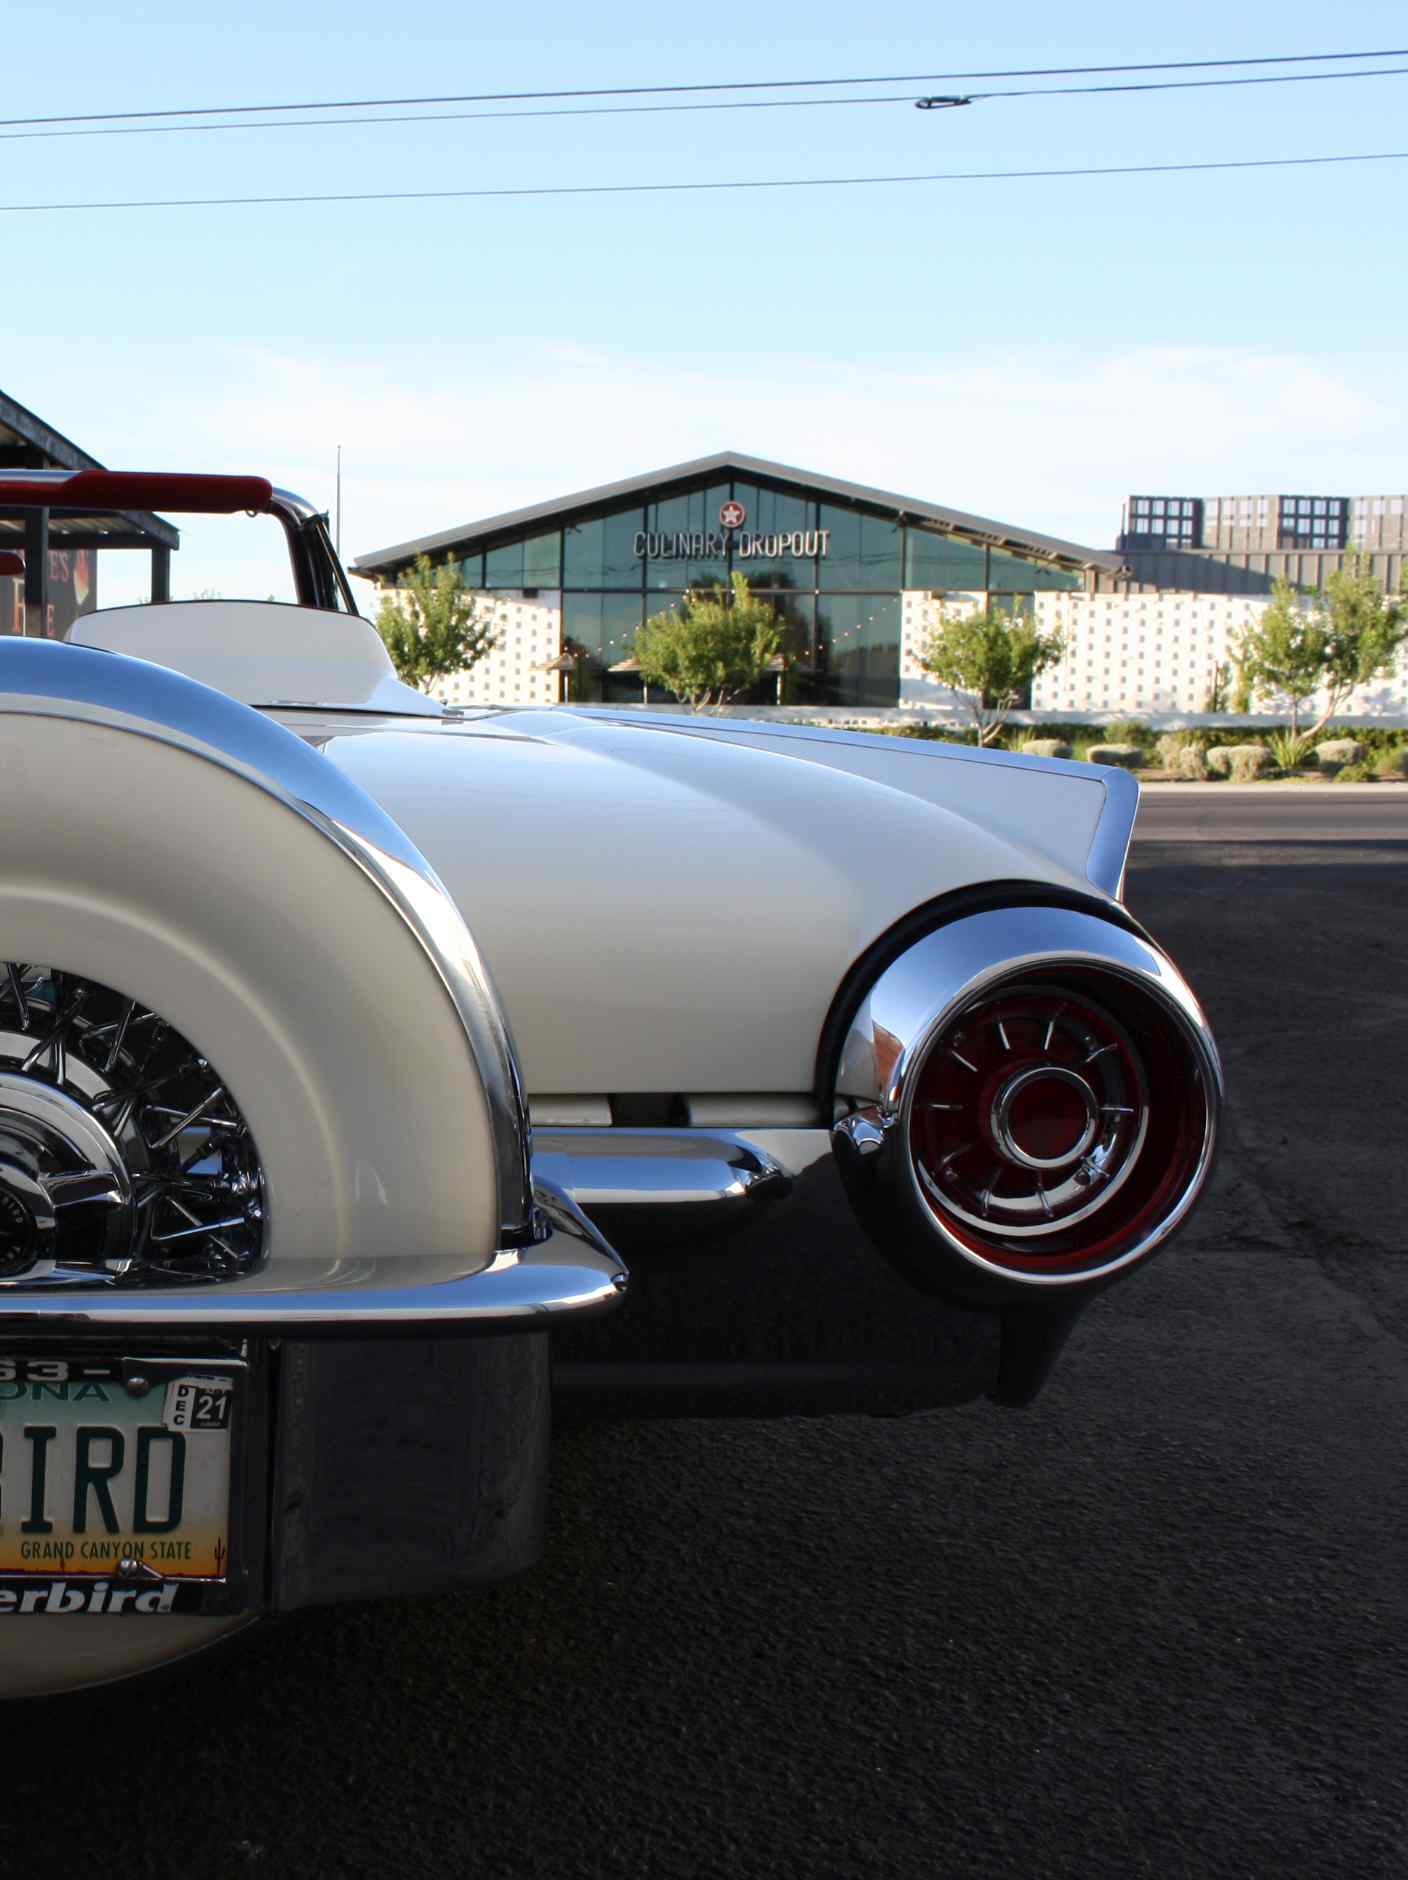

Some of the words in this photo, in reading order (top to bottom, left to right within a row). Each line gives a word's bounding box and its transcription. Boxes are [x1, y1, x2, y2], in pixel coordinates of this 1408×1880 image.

[634, 530, 730, 557] CULINARY
[739, 530, 830, 557] DROPOUT
[196, 1395, 227, 1421] 21
[20, 1541, 74, 1560] GRAND
[81, 1541, 144, 1560] CANYON
[151, 1541, 192, 1560] STATE
